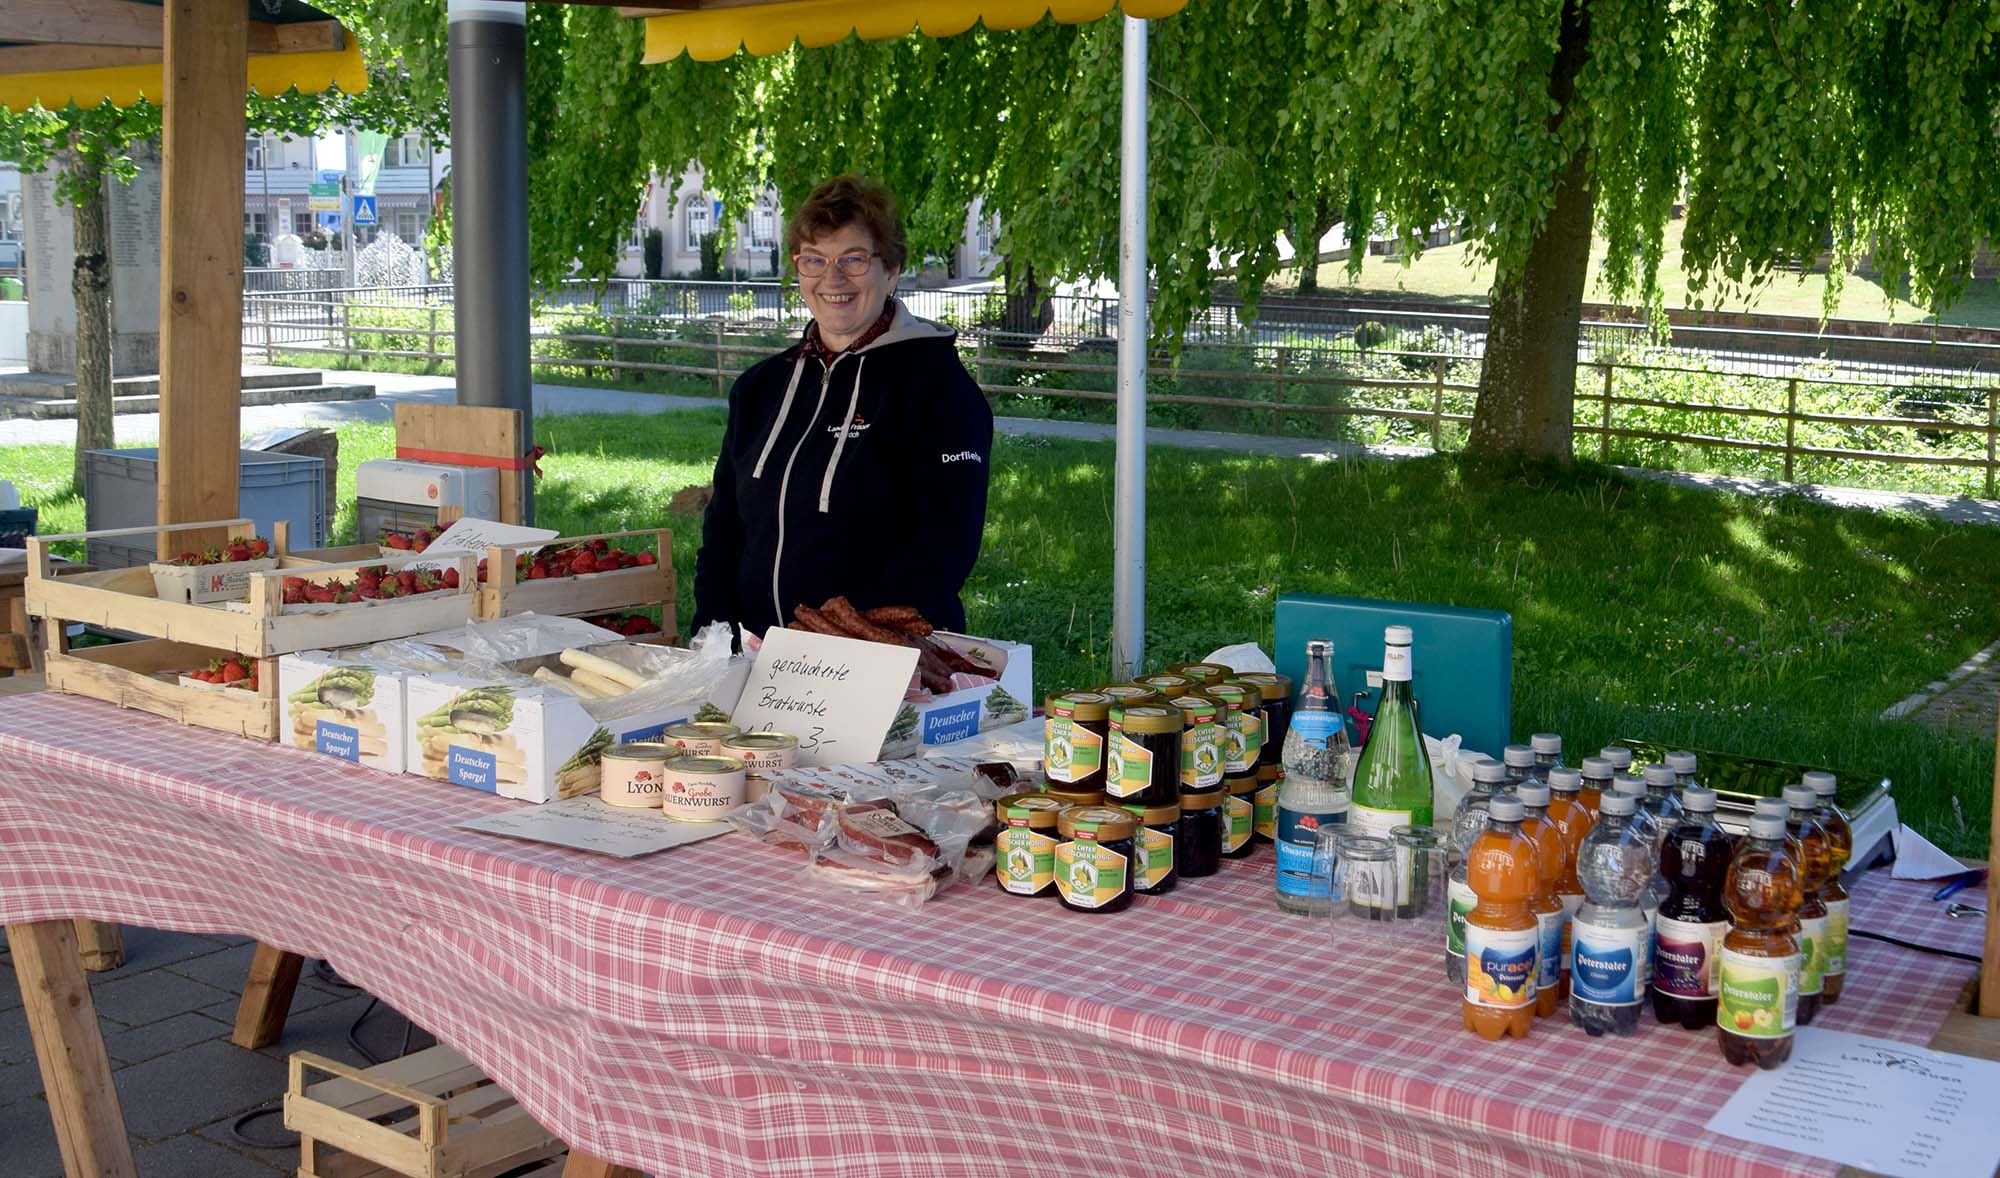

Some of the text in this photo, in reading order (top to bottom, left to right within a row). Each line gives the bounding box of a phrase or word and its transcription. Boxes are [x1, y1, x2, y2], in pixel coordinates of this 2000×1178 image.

[758, 686, 829, 717] Bratwürste
[929, 710, 977, 730] Deutscher
[321, 727, 354, 743] Deutscher
[325, 742, 351, 757] Spargel
[454, 753, 491, 770] Deutscher
[458, 768, 486, 784] Spargel
[627, 781, 663, 794] LYON
[688, 787, 713, 800] Grobe
[1280, 843, 1313, 858] Schwarzw
[1577, 952, 1627, 972] Peterstaler
[1656, 946, 1700, 965] Peterstaler
[1723, 981, 1773, 1001] Peterstaler
